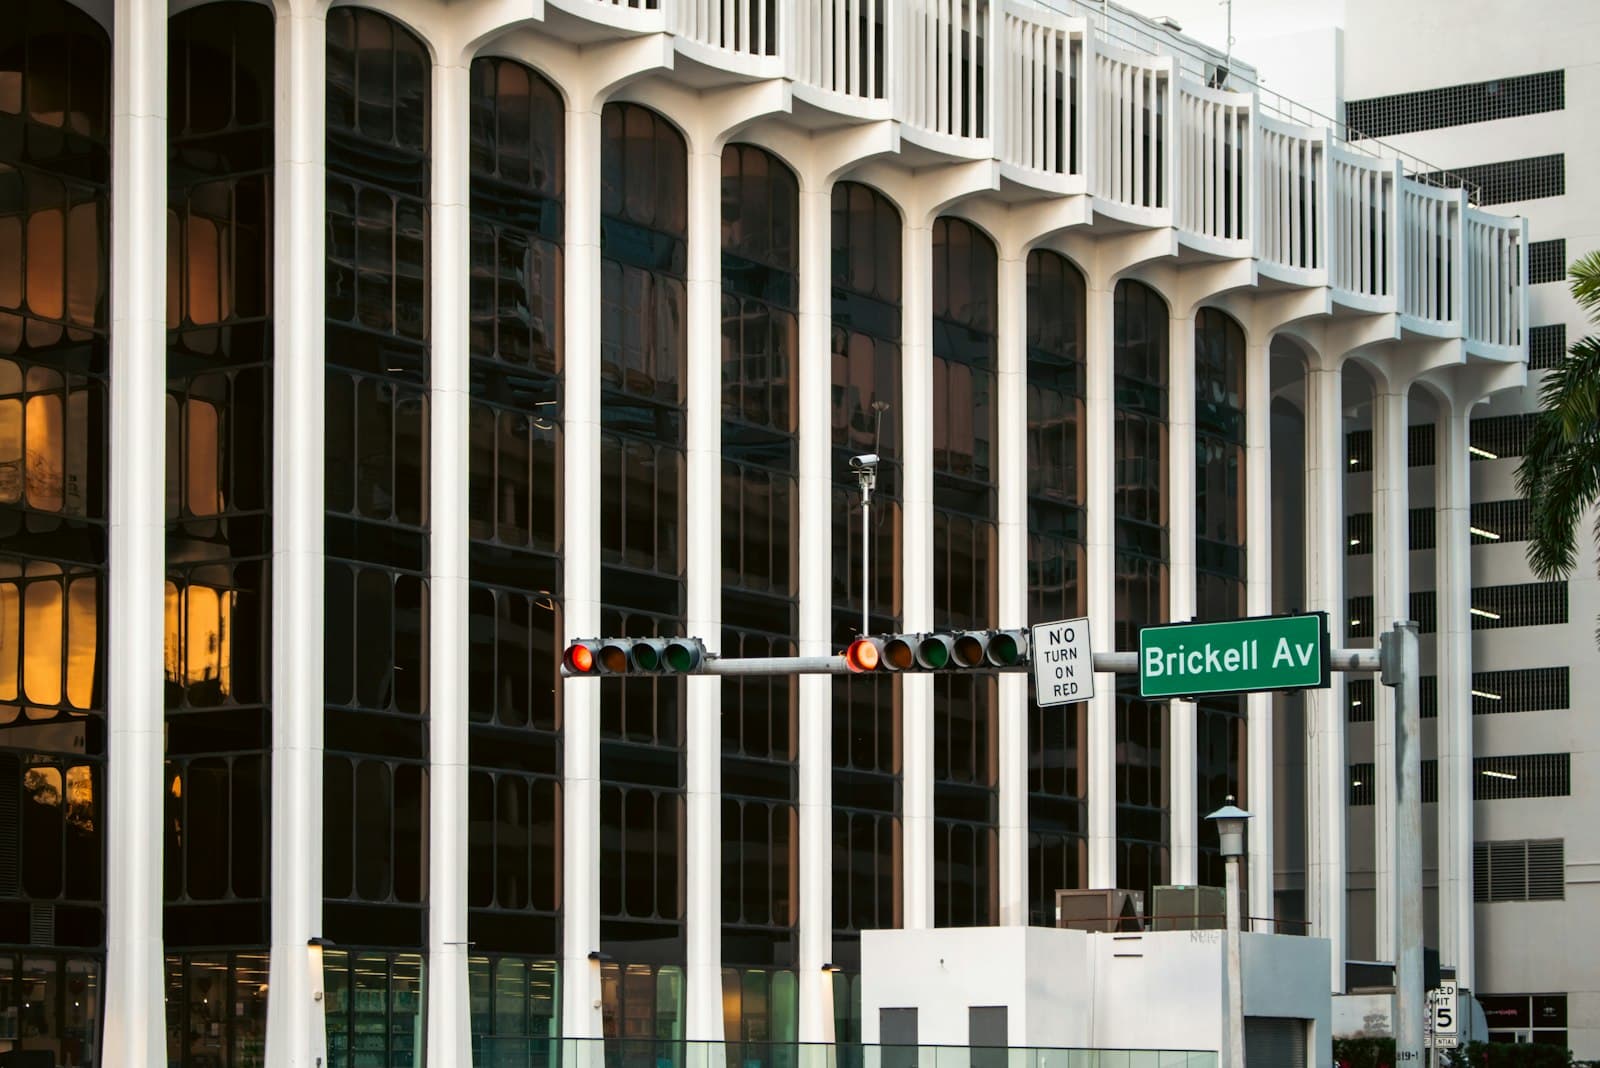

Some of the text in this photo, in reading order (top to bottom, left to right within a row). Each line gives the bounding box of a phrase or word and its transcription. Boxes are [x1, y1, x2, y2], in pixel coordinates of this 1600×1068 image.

[1049, 627, 1075, 646] NO
[1044, 647, 1077, 664] TURN
[1145, 637, 1315, 678] Brickell Av
[1055, 665, 1074, 679] ON
[1053, 682, 1078, 697] RED
